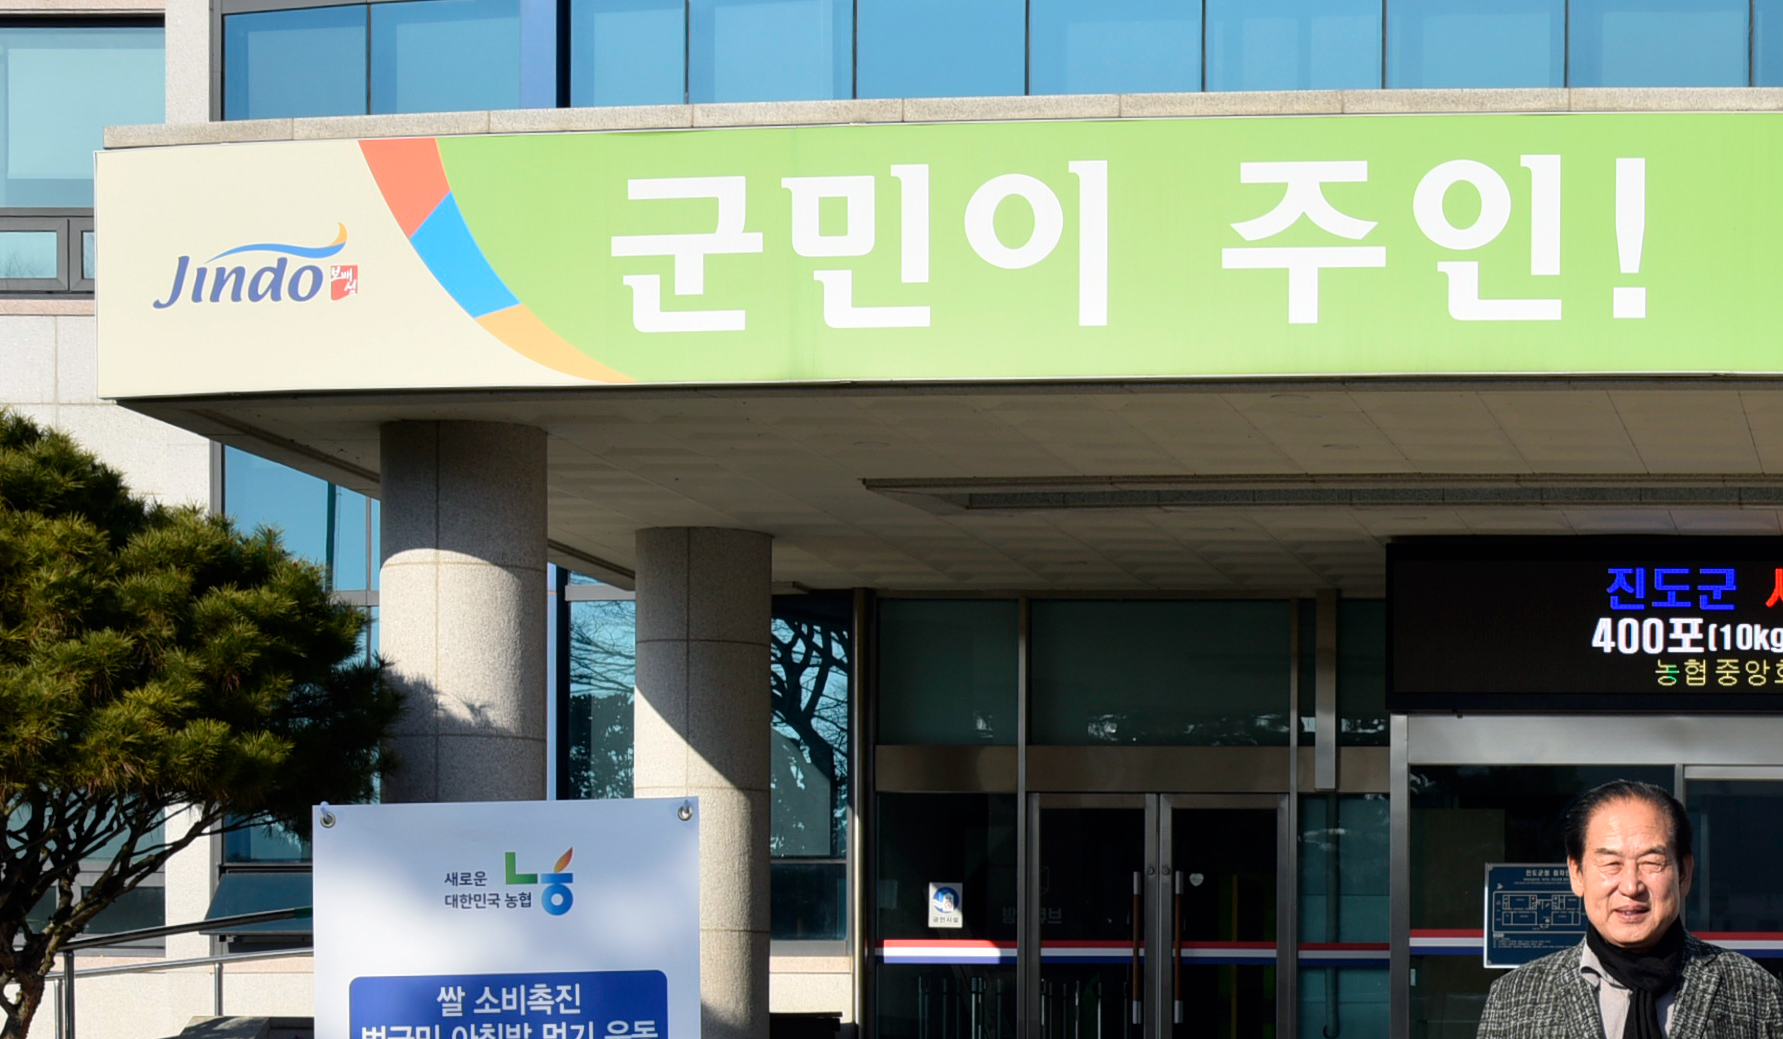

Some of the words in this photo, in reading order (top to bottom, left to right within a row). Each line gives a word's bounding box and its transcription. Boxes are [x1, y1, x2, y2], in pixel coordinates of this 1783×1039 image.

[611, 160, 1109, 333] 군민이
[1222, 155, 1647, 324] 주인!
[153, 255, 324, 309] Jindo
[1608, 567, 1737, 610] 진도군
[445, 872, 485, 886] 새로운
[445, 893, 500, 909] 대한민국
[506, 892, 531, 908] 농협
[437, 986, 465, 1016] 쌀
[474, 984, 580, 1015] 소비촉진
